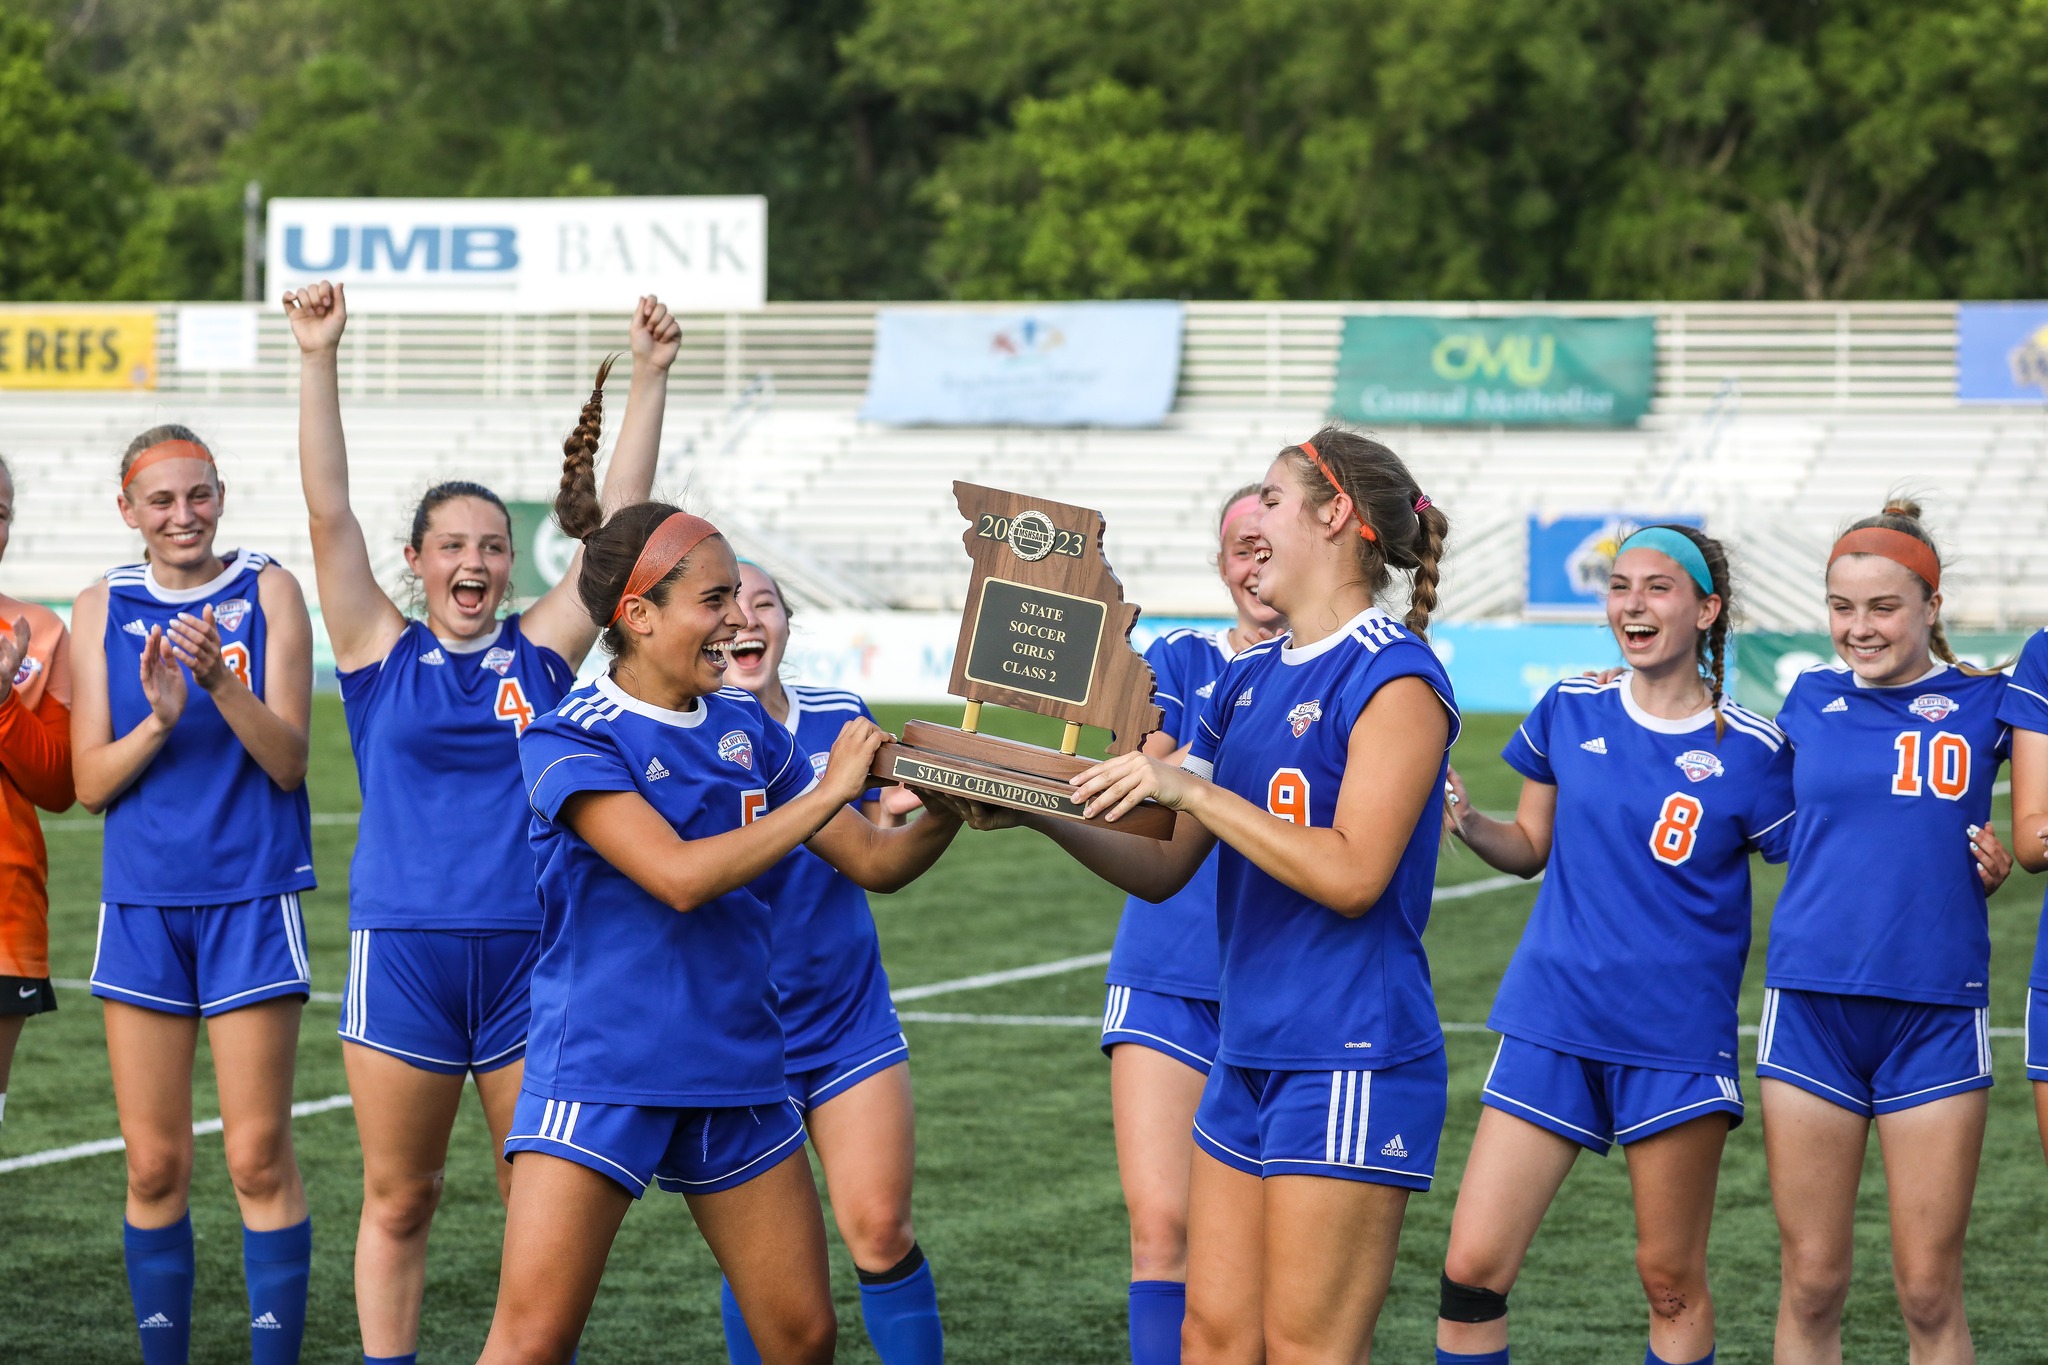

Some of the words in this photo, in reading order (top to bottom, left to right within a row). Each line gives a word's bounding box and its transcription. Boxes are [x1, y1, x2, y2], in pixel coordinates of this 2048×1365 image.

[283, 226, 519, 272] UMB
[556, 221, 747, 273] BANK
[25, 328, 120, 372] REFS
[1432, 334, 1555, 387] CMU
[978, 514, 1009, 540] 20
[1055, 531, 1084, 557] 23
[1009, 620, 1066, 643] SOCCER
[1020, 601, 1064, 622] STATE
[1002, 660, 1046, 680] CLASS
[1048, 671, 1057, 683] 2
[1012, 642, 1056, 661] GIRLS
[494, 677, 535, 739] 4
[916, 765, 961, 787] STATE
[964, 777, 1060, 810] CHAMPIONS
[1891, 731, 1971, 801] 10
[1267, 767, 1310, 827] 9
[1649, 791, 1704, 866] 8
[1381, 1148, 1408, 1158] adidas
